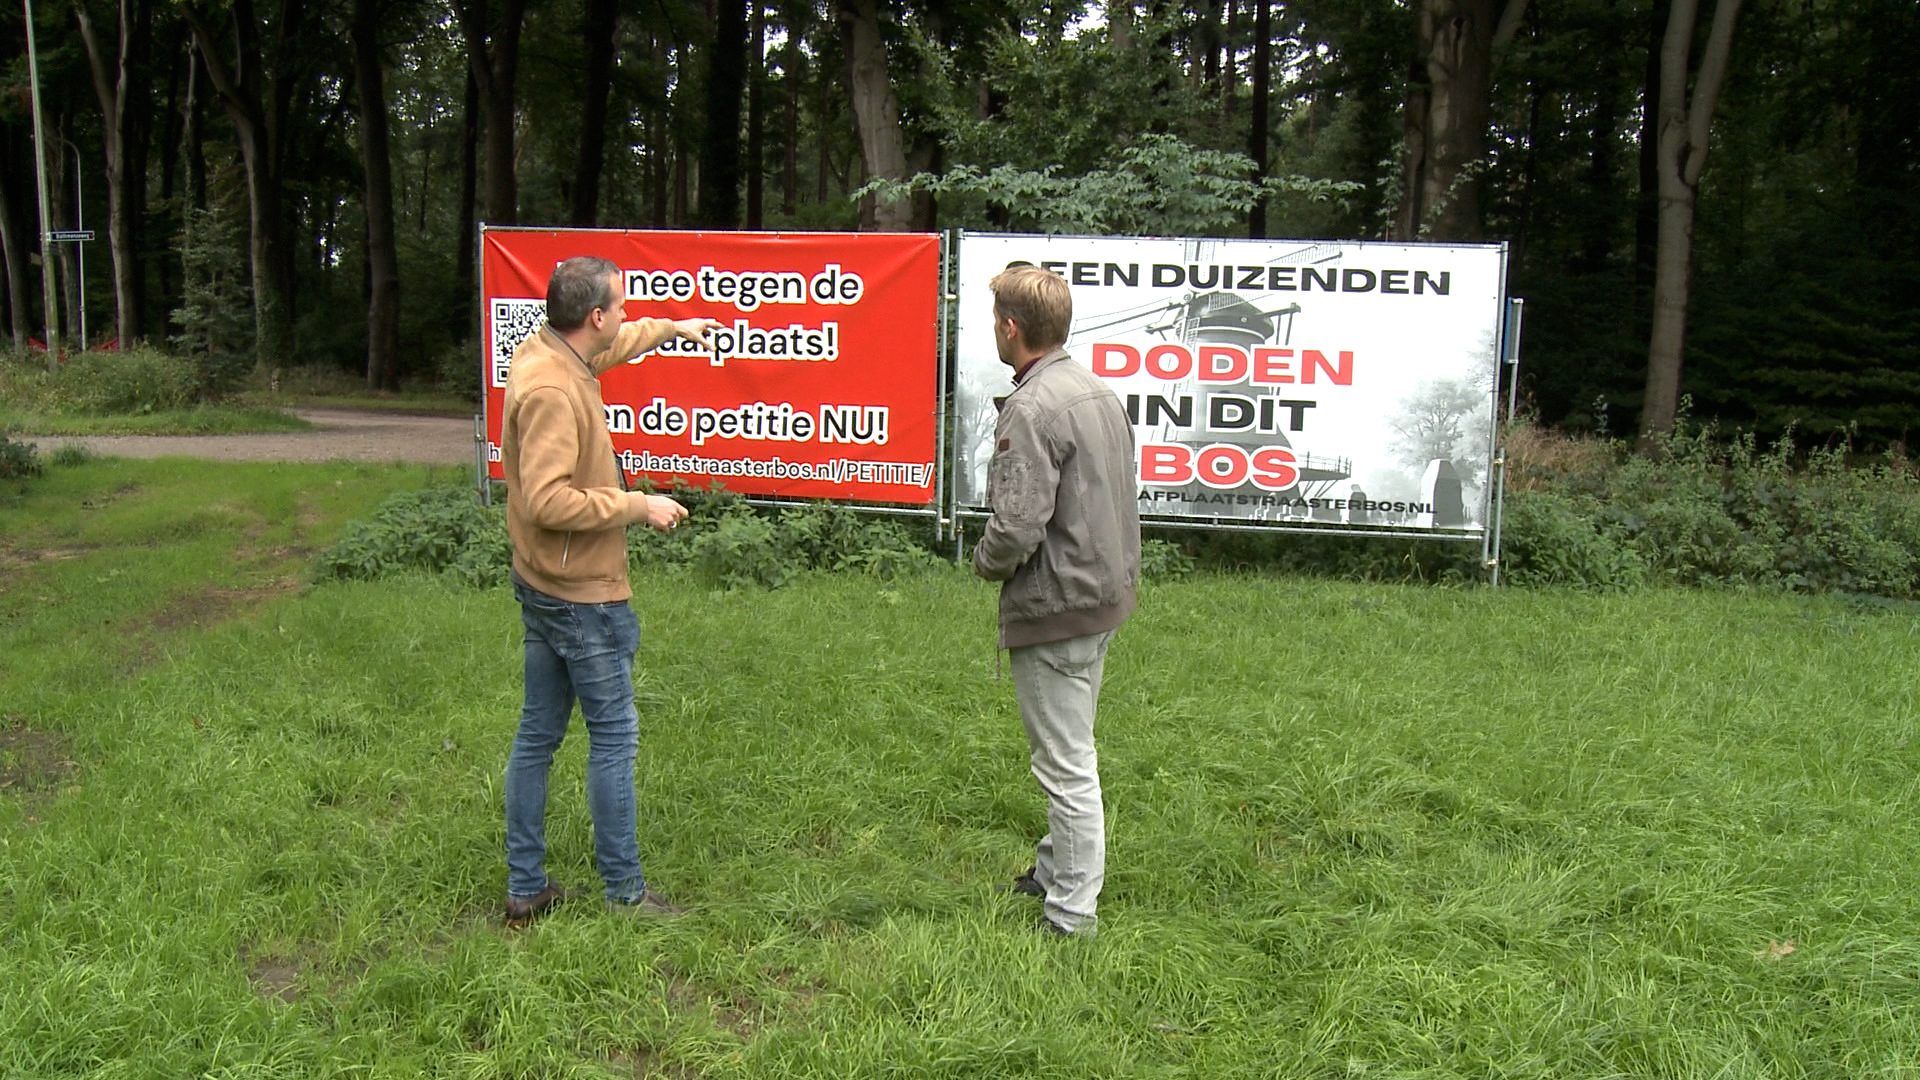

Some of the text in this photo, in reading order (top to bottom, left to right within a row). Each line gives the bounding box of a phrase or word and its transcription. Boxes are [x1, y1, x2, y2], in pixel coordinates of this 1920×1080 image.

[629, 268, 860, 307] nee tegen de
[1006, 261, 1450, 296] EN DUIZENDEN
[1092, 343, 1354, 386] DODEN
[642, 402, 685, 432] de
[695, 405, 812, 442] petitie
[822, 408, 886, 442] NU!
[1127, 394, 1317, 432] IN DIT
[1141, 445, 1298, 488] BOS
